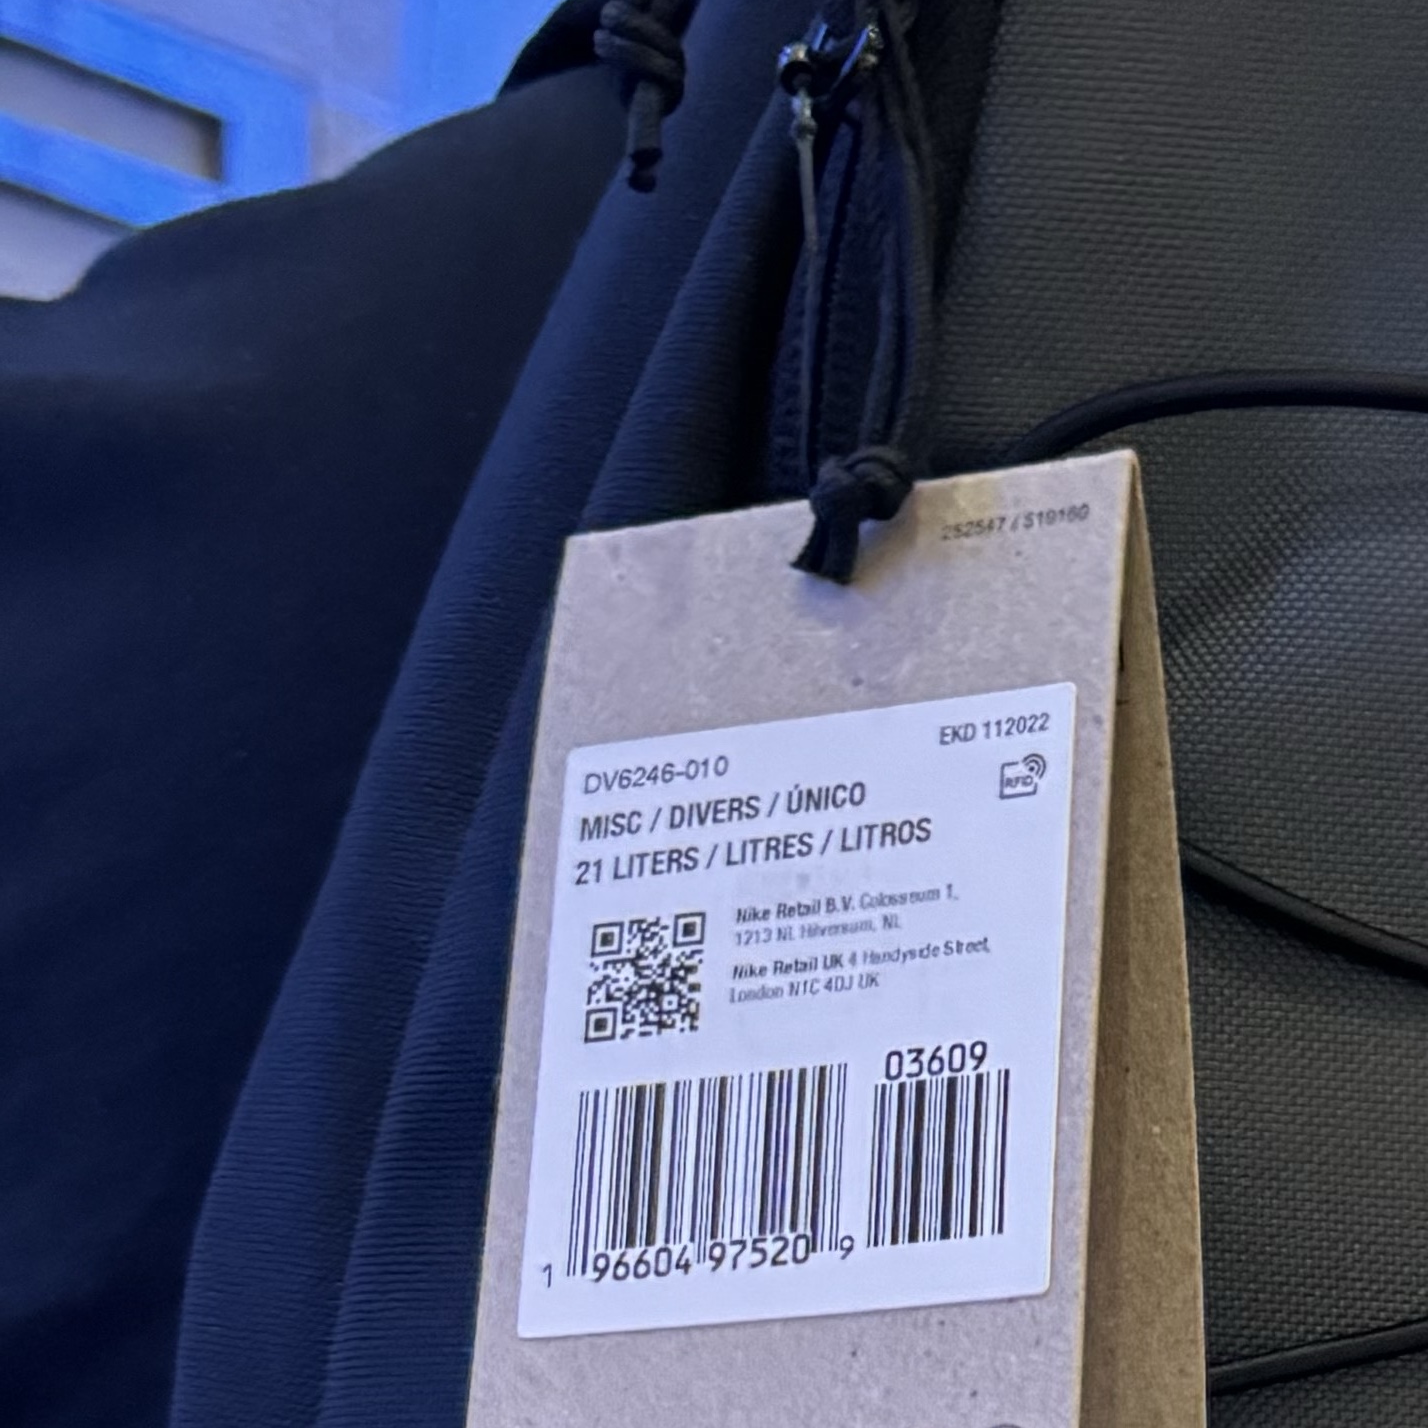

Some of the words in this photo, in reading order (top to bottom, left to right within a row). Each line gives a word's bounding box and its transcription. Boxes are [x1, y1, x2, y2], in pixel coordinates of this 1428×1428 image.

[939, 722, 976, 746] EKD
[982, 712, 1050, 740] 112022
[584, 755, 729, 794] DV6246-010
[579, 810, 642, 842] MISC
[650, 807, 663, 833] /
[669, 795, 761, 830] DIVERS
[767, 791, 780, 818] /
[786, 783, 866, 815] ÚNICO
[575, 858, 602, 886] 21
[613, 846, 700, 880] LITERS
[705, 843, 719, 870] /
[726, 832, 815, 867] LITRES
[820, 828, 834, 856] /
[839, 817, 932, 853] LITROS
[736, 907, 770, 923] Nike
[776, 900, 821, 919] Retail
[825, 896, 855, 914] B.V.
[732, 963, 767, 980] Nike
[773, 956, 818, 975] Retail
[823, 952, 845, 971] UK
[729, 986, 784, 1004] London
[858, 972, 880, 989] UK
[885, 1040, 988, 1081] 03609
[543, 1263, 552, 1288] 1
[592, 1244, 692, 1283] 96604
[708, 1233, 810, 1272] 97520
[840, 1235, 854, 1260] 9
